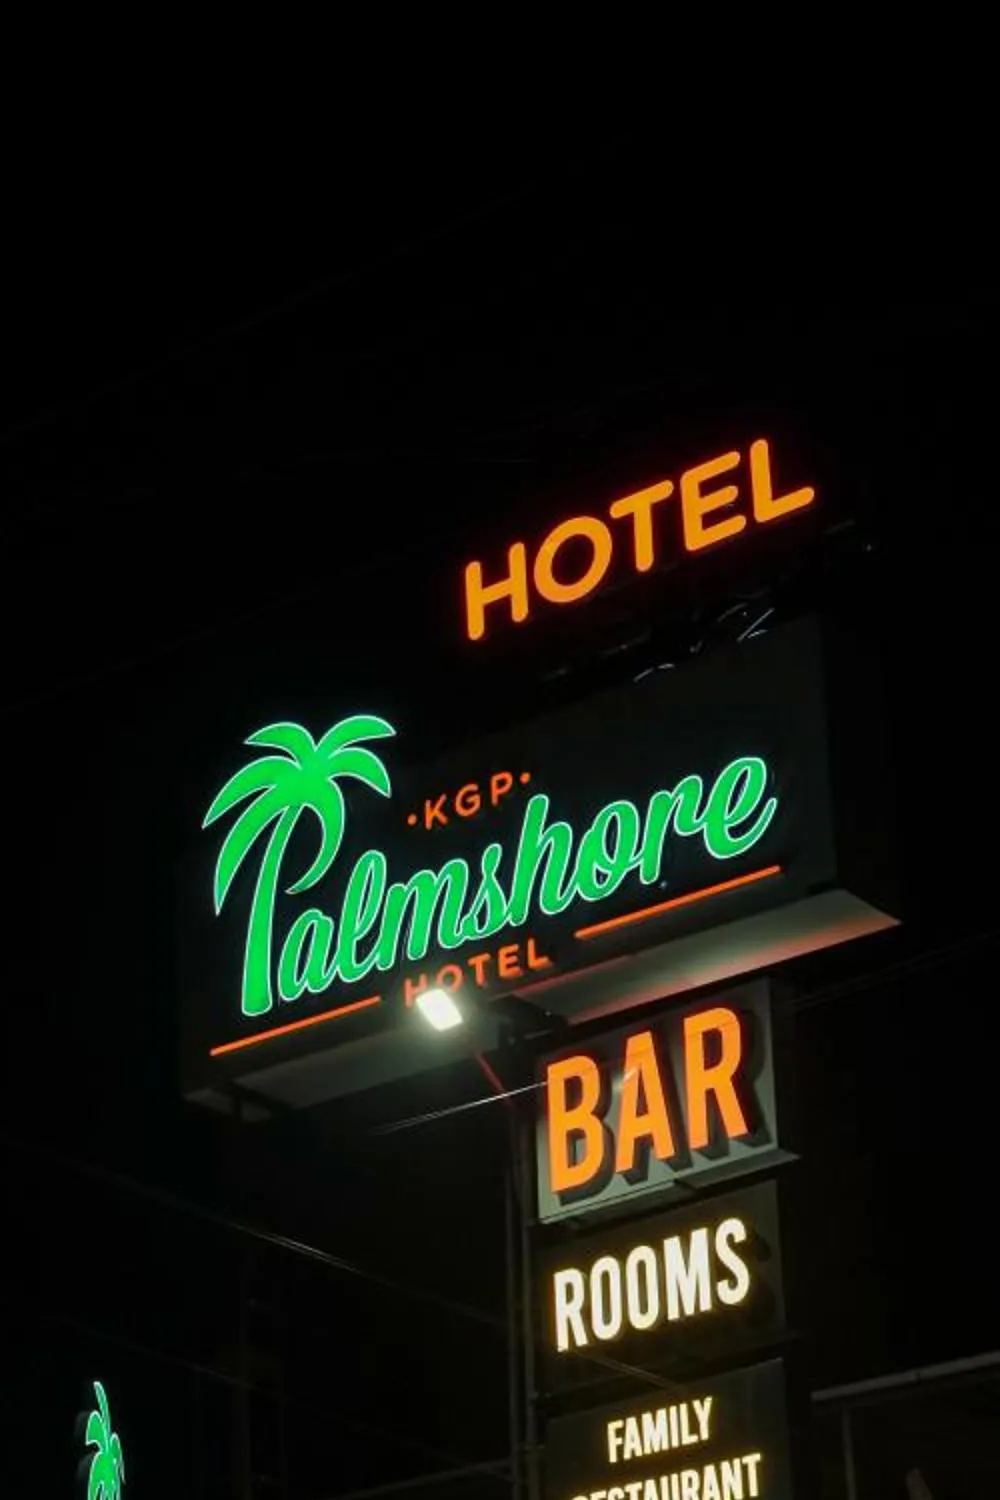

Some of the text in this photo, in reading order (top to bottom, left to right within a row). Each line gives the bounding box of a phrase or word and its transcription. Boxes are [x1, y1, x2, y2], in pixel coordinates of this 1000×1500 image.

[465, 439, 815, 640] HOTEL
[241, 757, 777, 1017] Palmshore
[404, 937, 552, 1009] HOTEL
[546, 1007, 747, 1192] BAR
[553, 1217, 750, 1353] ROOMS
[607, 1396, 712, 1464] FAMILY
